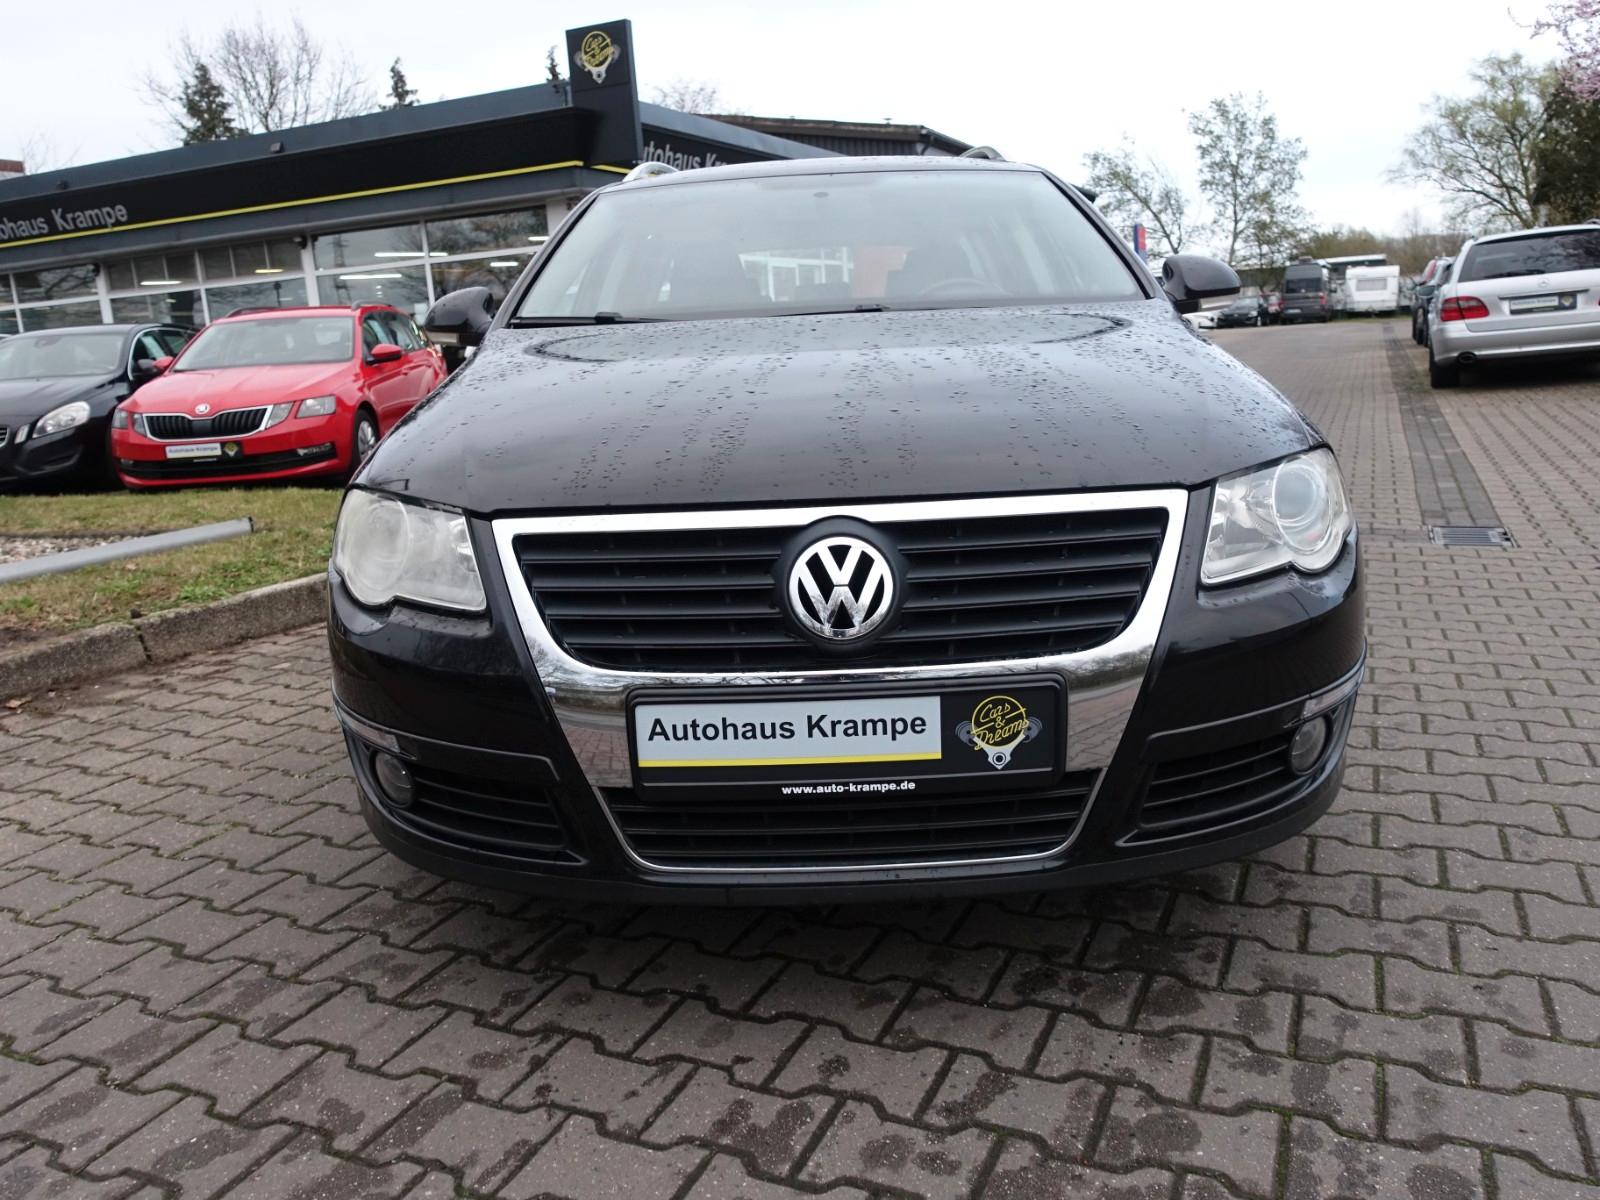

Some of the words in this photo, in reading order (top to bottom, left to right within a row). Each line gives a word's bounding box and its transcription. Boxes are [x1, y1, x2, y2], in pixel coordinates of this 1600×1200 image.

[51, 204, 128, 231] Krampe
[980, 703, 1011, 722] Cars
[995, 716, 1006, 728] &
[648, 717, 796, 741] Autohaus
[806, 714, 927, 741] Krampe
[974, 719, 1029, 750] Dreams
[781, 781, 916, 794] www.auto-krampe.de
